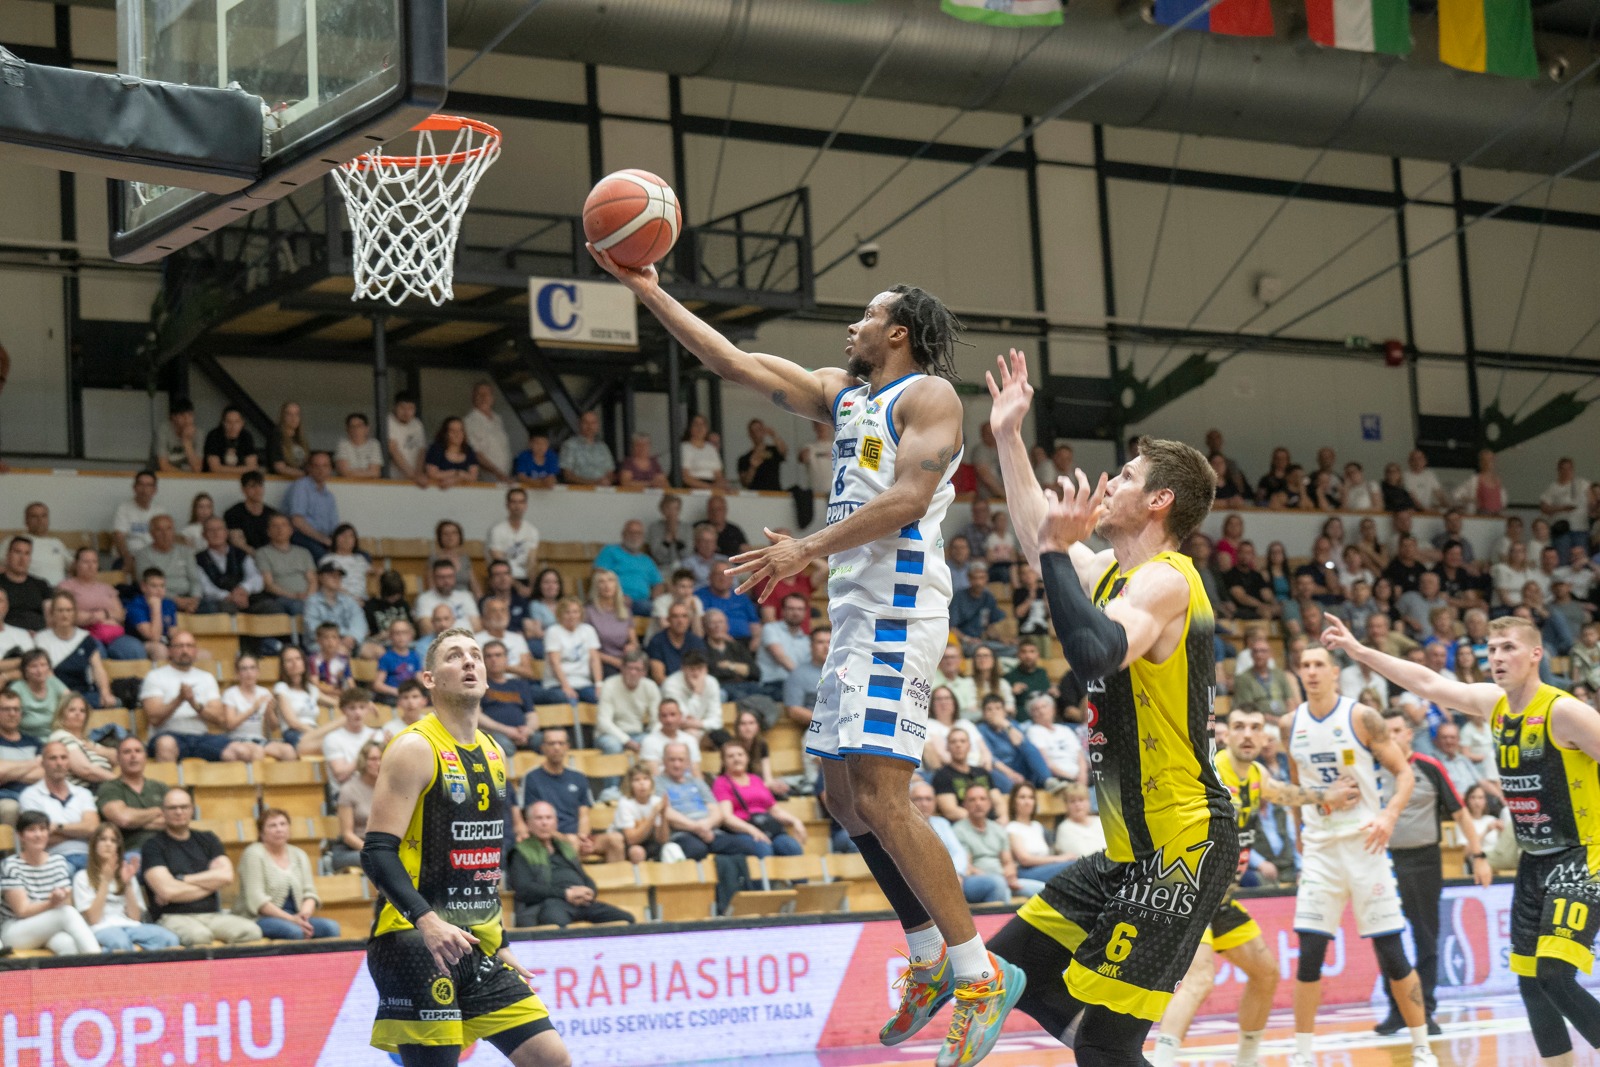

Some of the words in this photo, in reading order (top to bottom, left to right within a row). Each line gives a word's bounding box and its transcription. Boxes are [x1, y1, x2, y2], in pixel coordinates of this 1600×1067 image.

[537, 283, 578, 332] C
[1500, 743, 1520, 768] 10
[477, 782, 490, 811] 3
[1552, 897, 1589, 931] 10
[1105, 921, 1139, 963] 6
[570, 1017, 612, 1037] PLUS
[616, 1010, 684, 1033] SERVICE
[688, 1004, 759, 1029] CSOPORT
[765, 1001, 815, 1021] TAGJA
